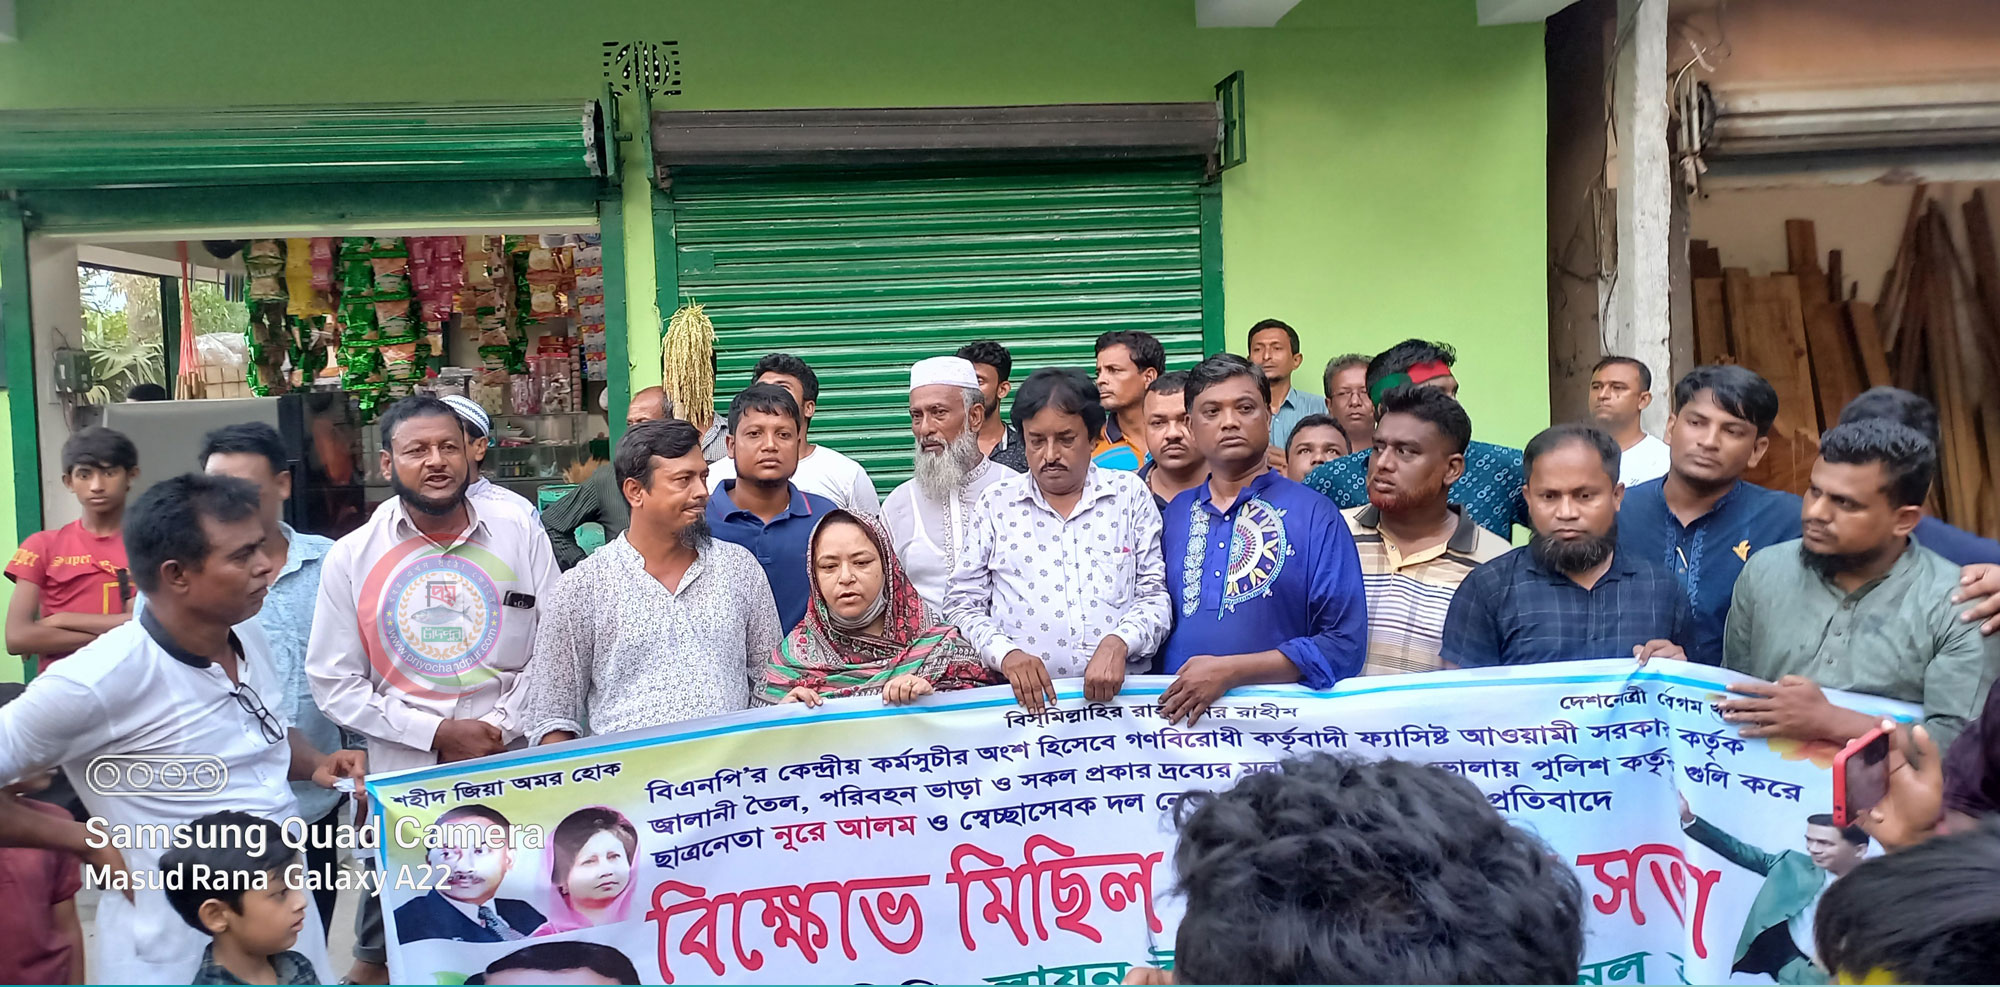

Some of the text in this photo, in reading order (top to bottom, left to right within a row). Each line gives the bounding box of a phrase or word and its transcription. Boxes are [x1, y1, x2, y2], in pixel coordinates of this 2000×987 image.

[1234, 703, 1299, 721] রাহীম
[1560, 687, 1647, 711] দেশনেত্রী
[778, 754, 861, 783] কেন্দ্রীয়
[975, 740, 1030, 763] অংশ
[1038, 734, 1115, 758] হিসেবে
[1125, 726, 1244, 750] গণবিরোধী
[1252, 725, 1348, 753] কর্তৃবাদী
[1355, 723, 1450, 748] ফ্যাসিষ্ট
[1457, 717, 1580, 746] আওয়ামী
[1676, 728, 1747, 761] কর্তৃক
[391, 761, 625, 810] শহীদ জিয়া অমর হোক
[648, 801, 738, 835] জ্বালানী
[819, 785, 917, 808] পরিবহন
[924, 776, 983, 801] ভাড়া
[991, 778, 1012, 792] ও
[1020, 767, 1076, 790] সকল
[1085, 762, 1153, 782] প্রকার
[1158, 762, 1232, 782] দ্রব্যের
[1486, 784, 1614, 813] প্রতিবাদে
[1531, 753, 1610, 782] পুলিশ
[1684, 762, 1731, 790] গুলি
[1738, 775, 1806, 802] করে
[650, 827, 764, 870] ছাত্রনেতা
[770, 821, 828, 853] নূরে
[834, 816, 917, 840] আলম
[926, 814, 950, 831] ও
[960, 796, 1098, 831] স্বেচ্ছাসেবক
[1103, 793, 1146, 814] দল
[644, 834, 1164, 985] বিক্ষোভ মিছিল
